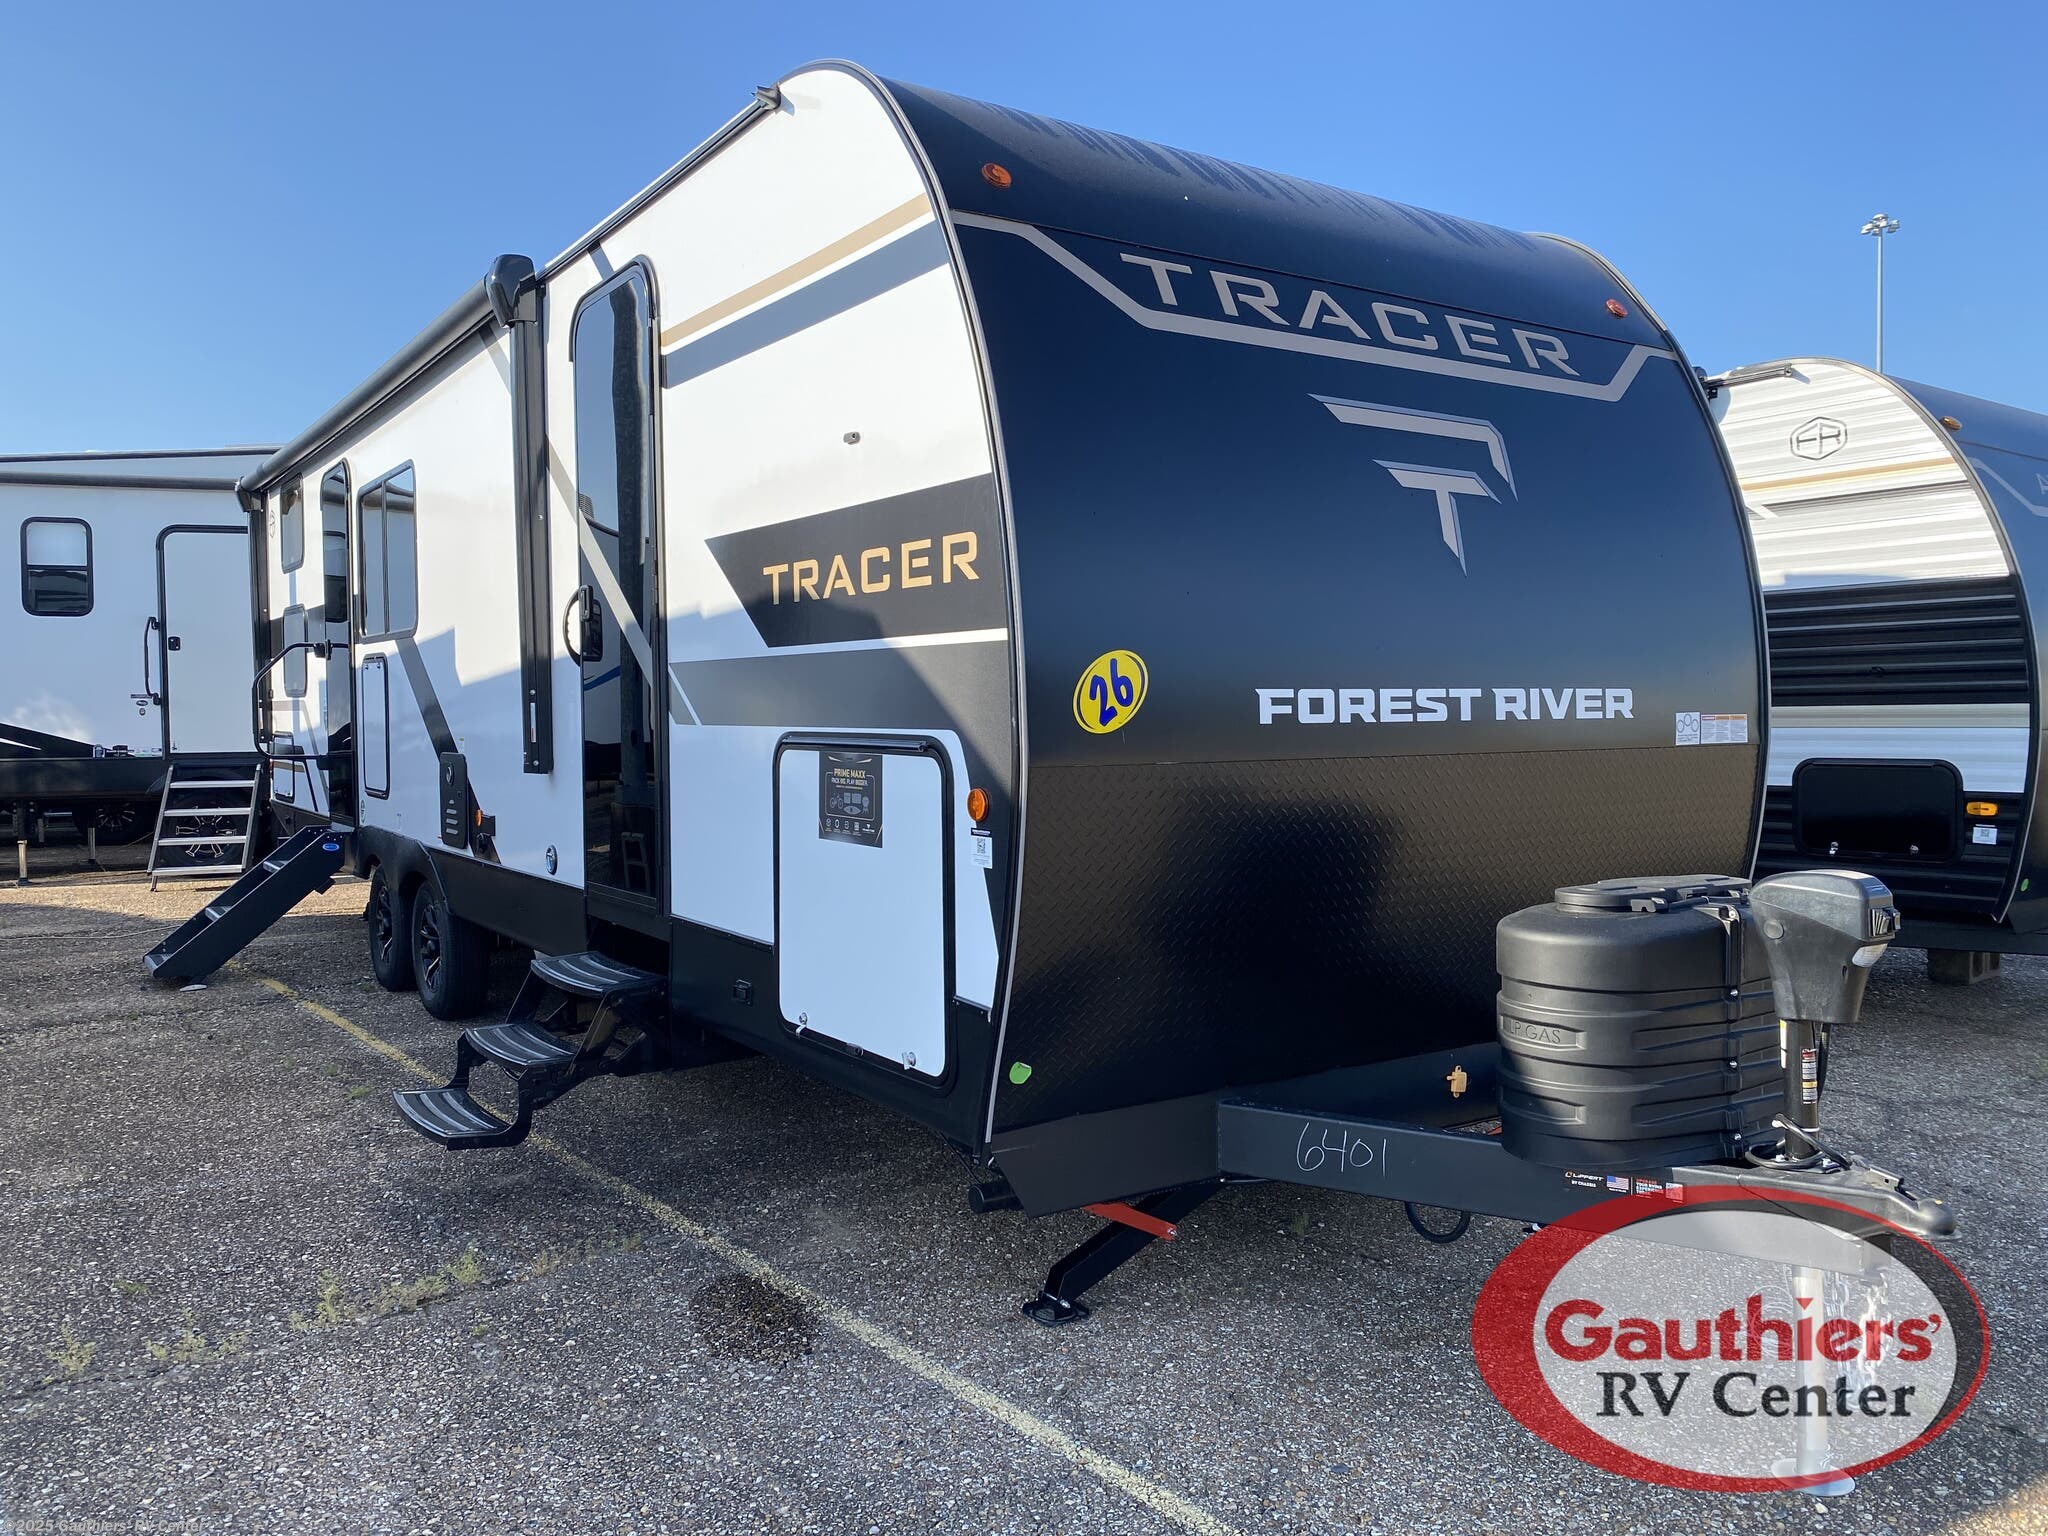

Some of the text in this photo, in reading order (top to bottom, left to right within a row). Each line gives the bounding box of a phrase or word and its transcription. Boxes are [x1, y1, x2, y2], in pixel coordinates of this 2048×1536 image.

[1120, 253, 1580, 376] TRACER
[762, 531, 980, 605] TRACER
[1088, 658, 1134, 726] 26
[1255, 687, 1634, 725] FOREST RIVER
[1525, 1025, 1561, 1044] GAS
[1296, 1121, 1387, 1177] 6401
